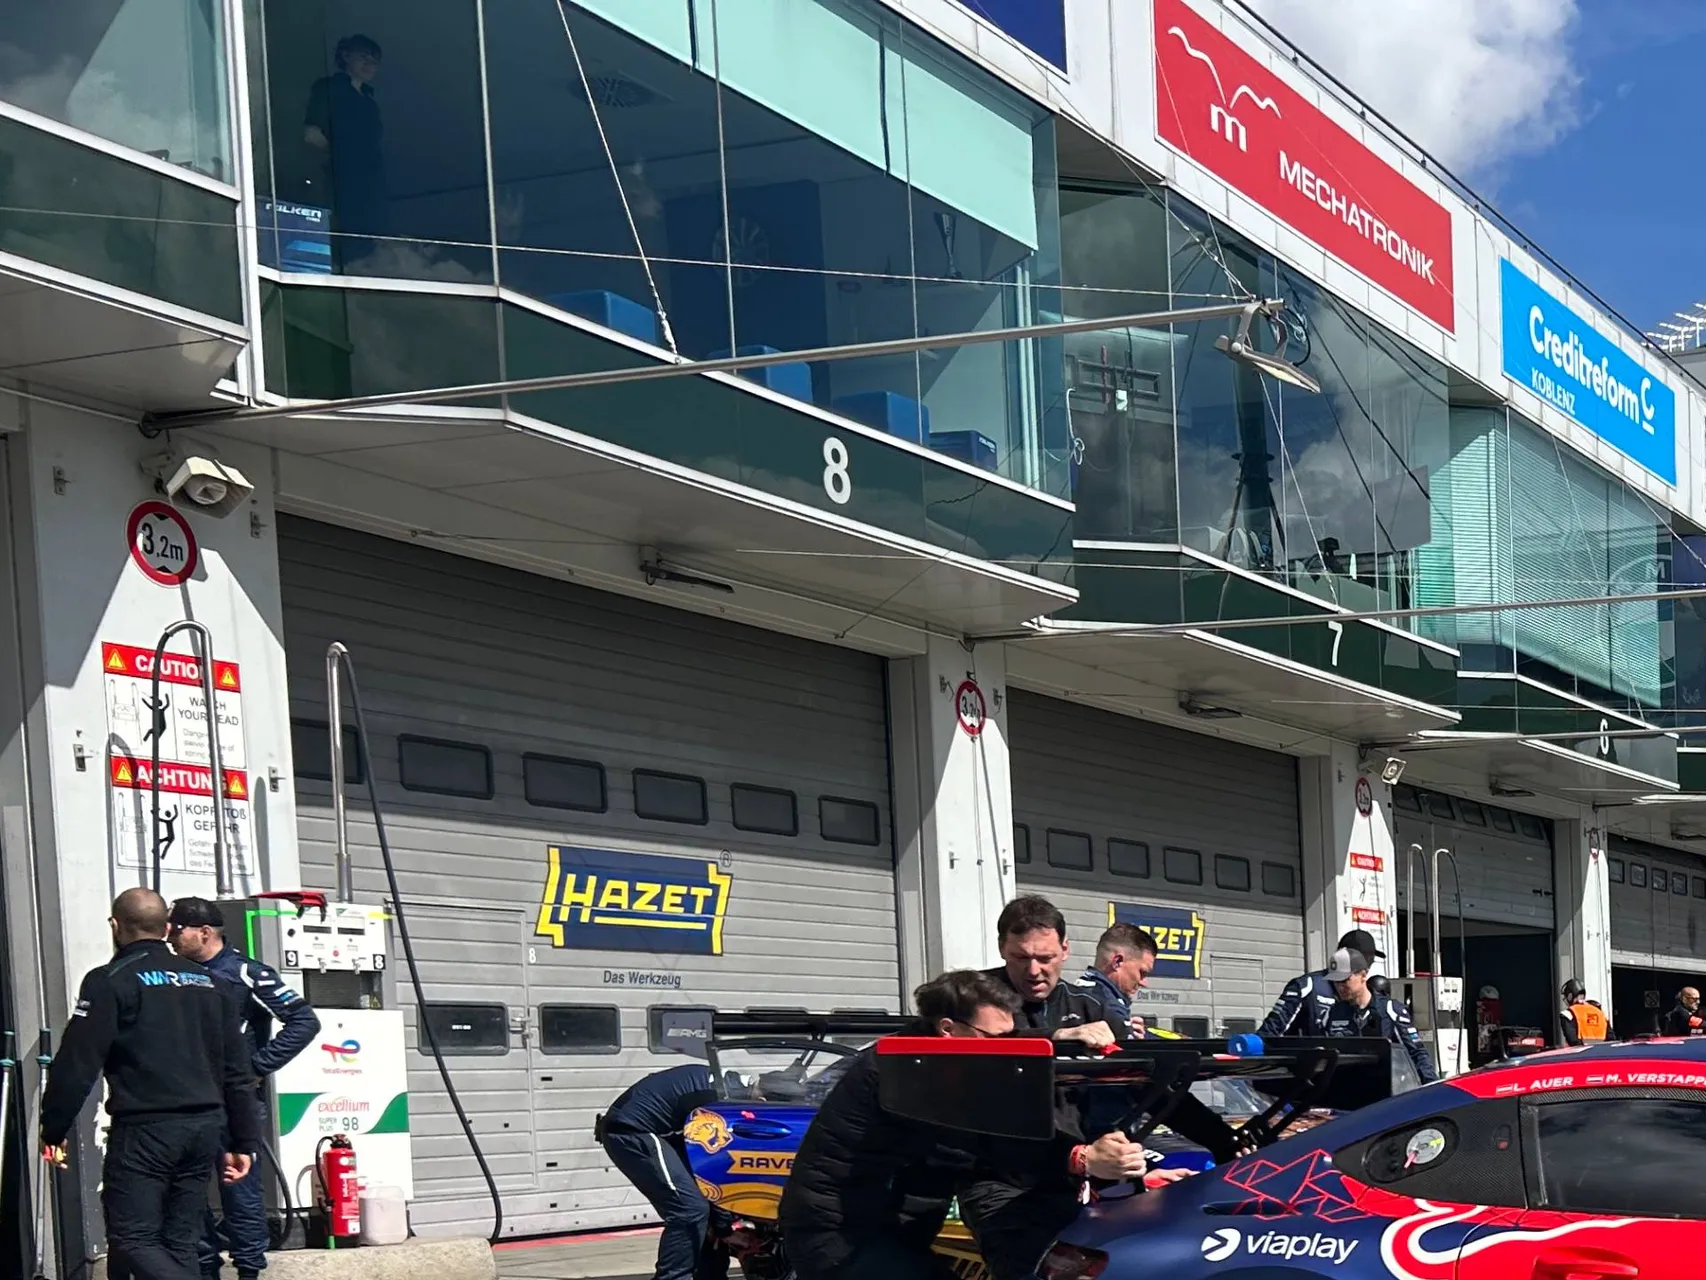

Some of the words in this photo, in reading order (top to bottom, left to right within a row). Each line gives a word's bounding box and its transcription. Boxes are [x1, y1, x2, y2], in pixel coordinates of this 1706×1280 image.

[1279, 149, 1435, 286] MECHATRONIK
[1529, 305, 1640, 424] Creditreform
[1530, 367, 1576, 416] KOBLENZ
[822, 436, 852, 505] 8
[141, 522, 185, 562] 3,2m
[1327, 620, 1344, 667] 7
[1600, 718, 1610, 756] 6
[559, 873, 713, 924] HAZET
[286, 951, 297, 967] 9
[374, 954, 385, 969] 8
[529, 947, 537, 964] 8
[603, 970, 626, 985] Das
[628, 971, 682, 988] Werkzeug
[1530, 1076, 1574, 1090] AUER
[1605, 1074, 1623, 1084] M.
[341, 1116, 360, 1132] 98
[1247, 1230, 1359, 1264] viaplay
